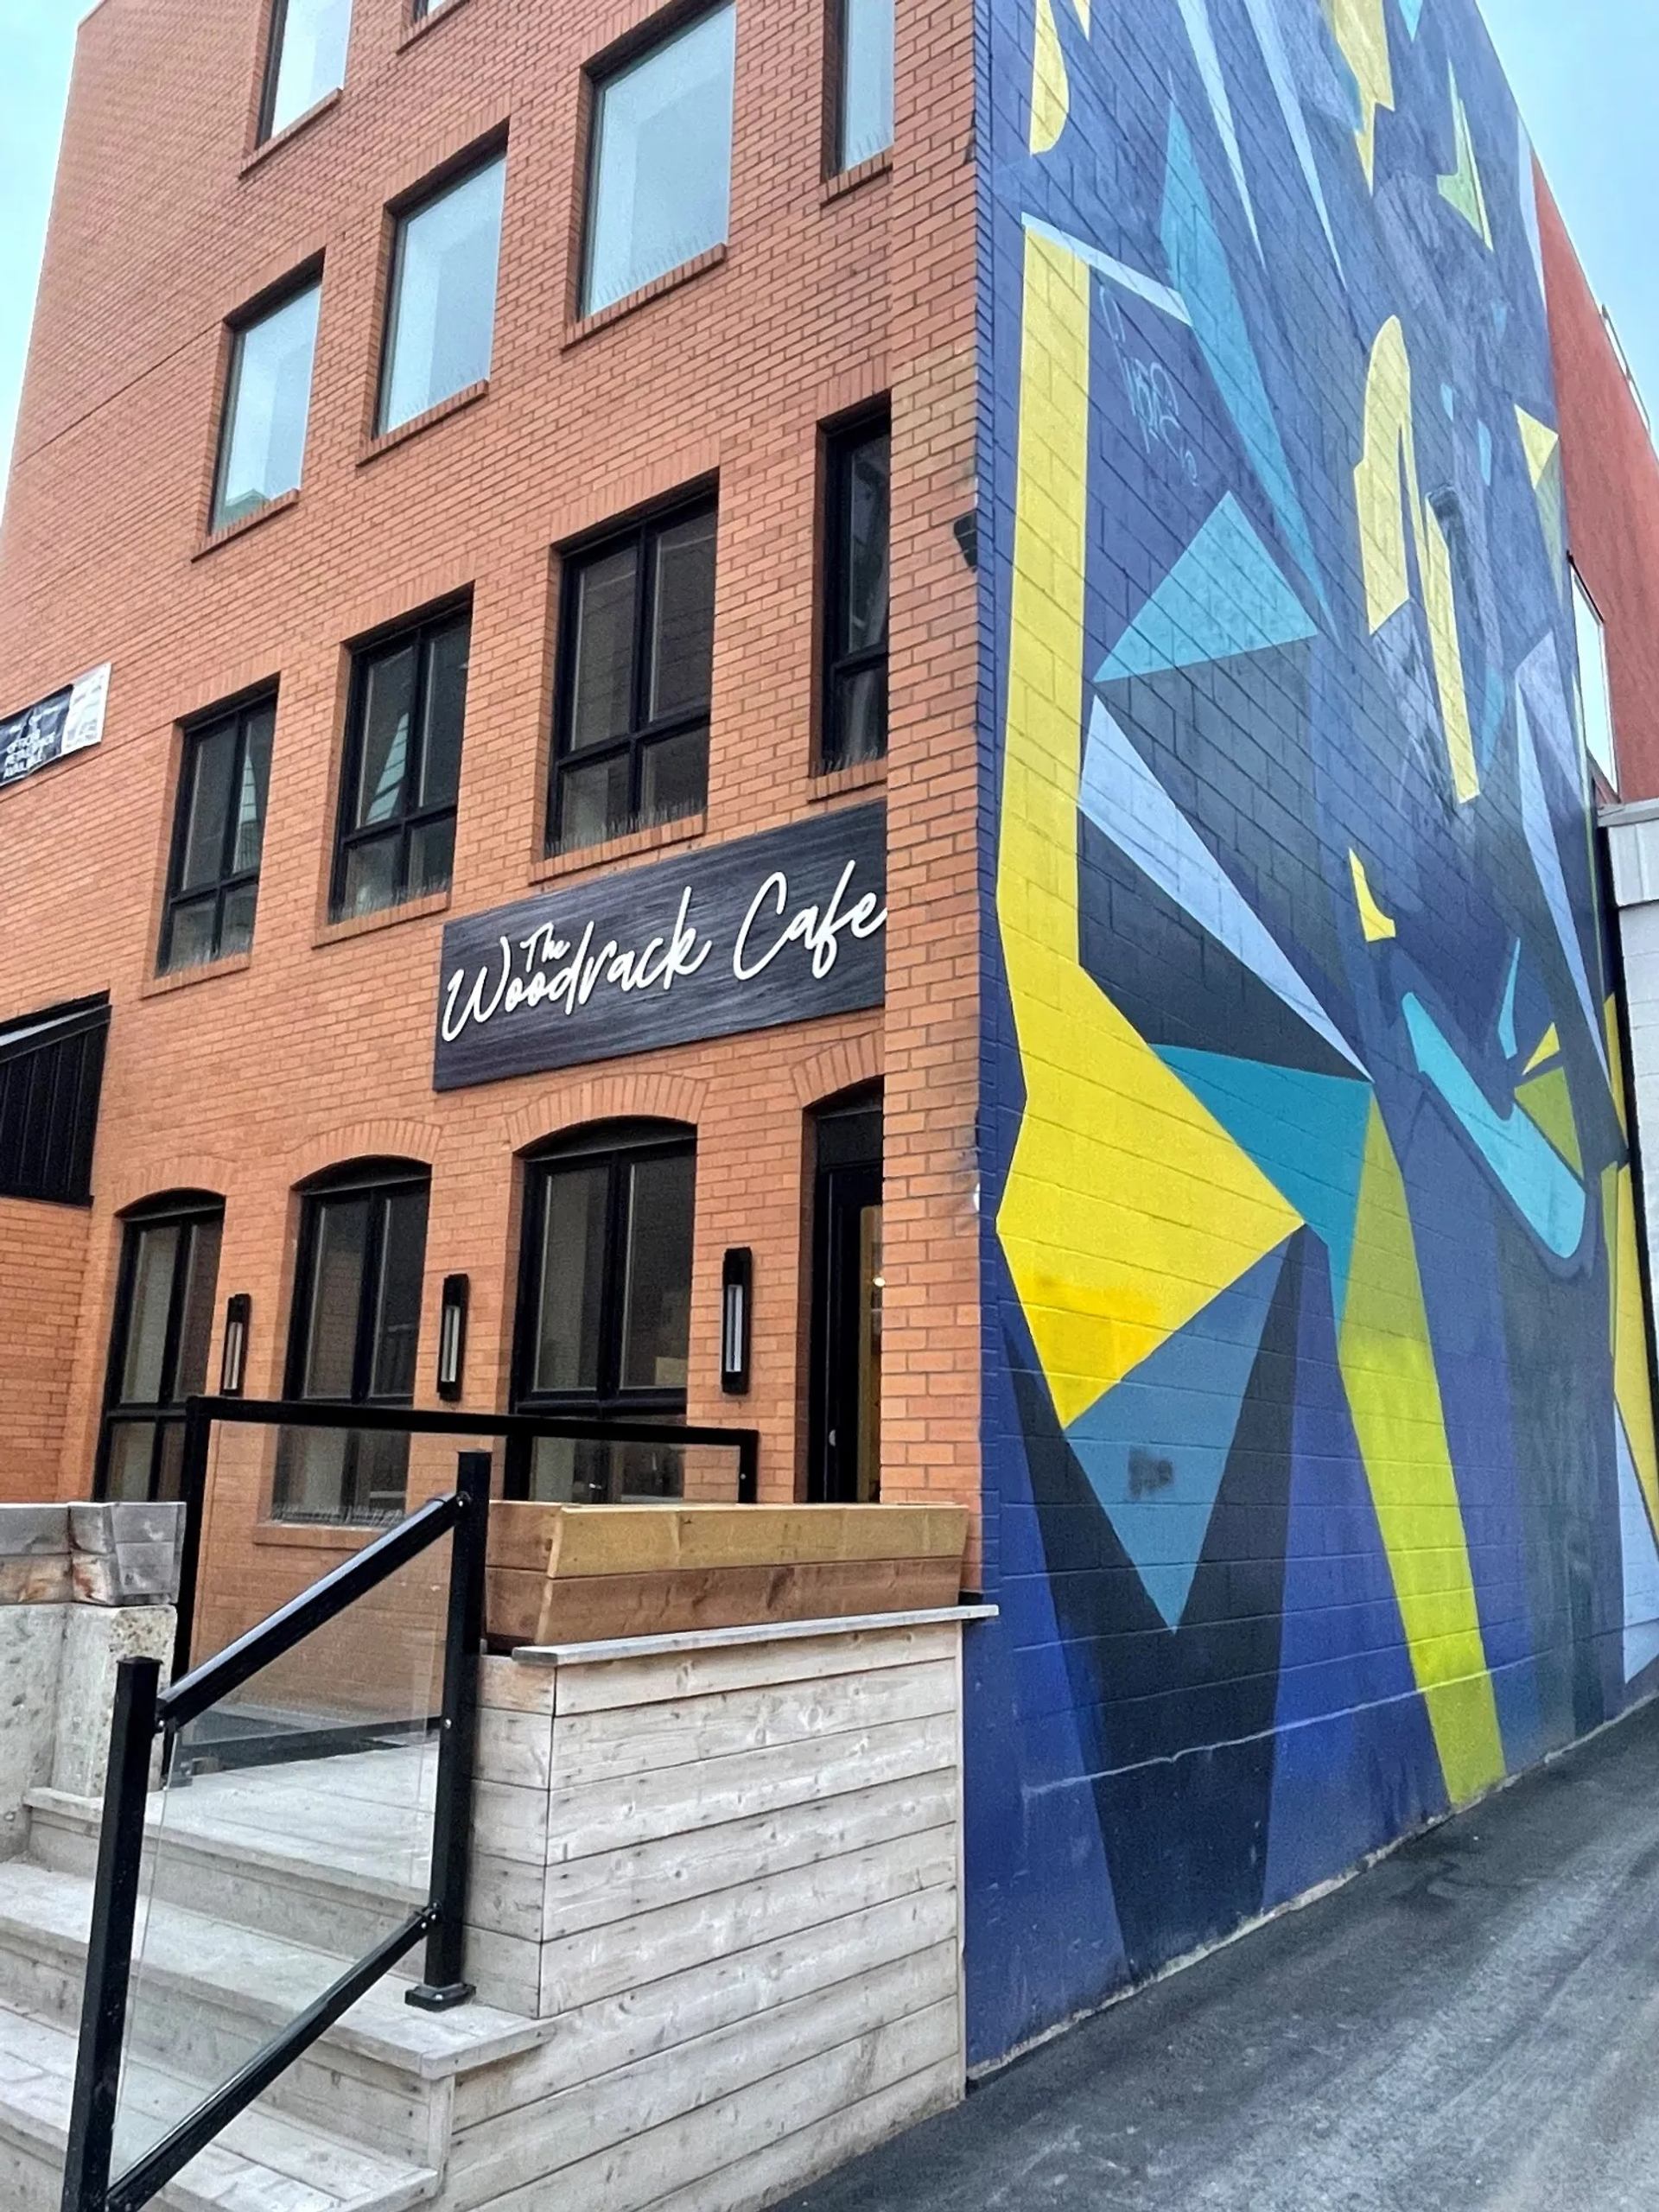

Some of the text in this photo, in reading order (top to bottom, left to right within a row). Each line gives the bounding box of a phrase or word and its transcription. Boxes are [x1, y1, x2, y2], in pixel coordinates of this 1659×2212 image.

[442, 860, 888, 1042] Woodrack Cafe
[519, 921, 570, 973] The
